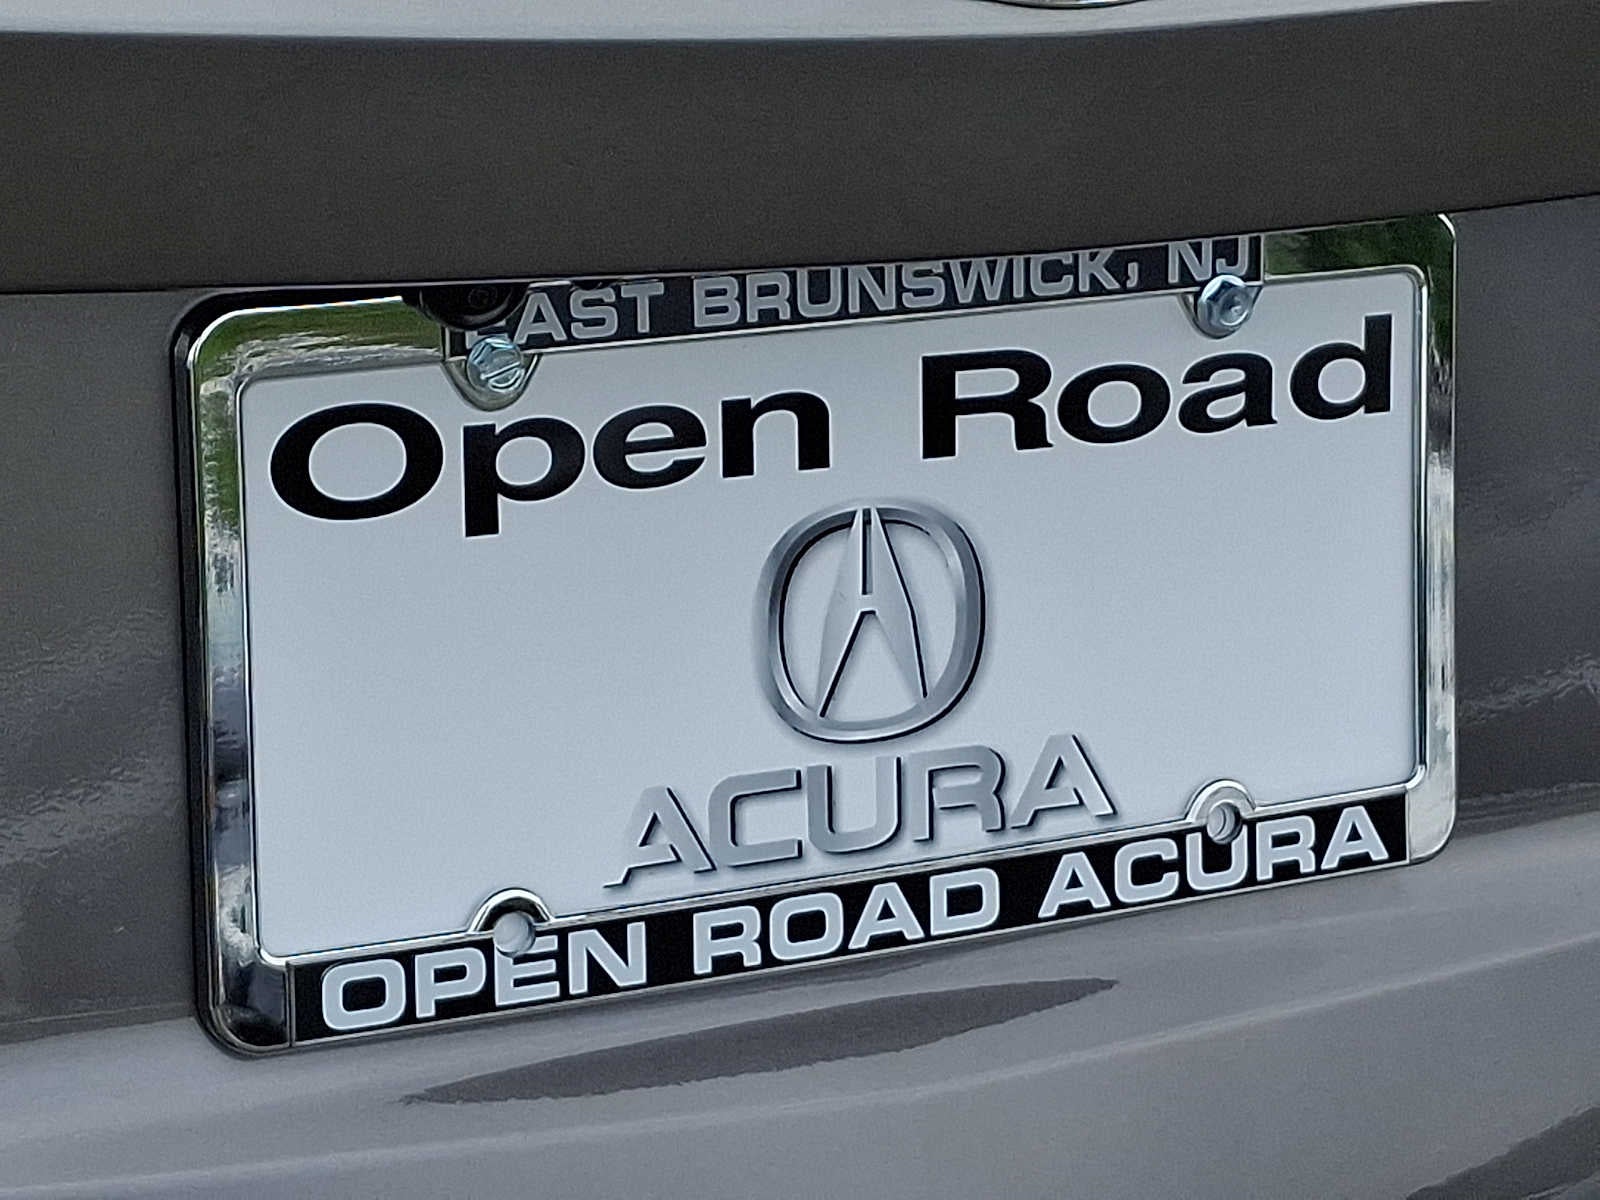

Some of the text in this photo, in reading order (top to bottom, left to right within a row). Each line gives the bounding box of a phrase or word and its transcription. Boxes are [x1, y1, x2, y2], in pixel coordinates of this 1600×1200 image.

[693, 248, 1140, 329] BRUNSWICK,
[1167, 234, 1250, 284] NJ
[270, 314, 1392, 538] Open Road
[604, 733, 1120, 888] ACURA
[321, 804, 1390, 1031] OPEN ROAD ACURA
